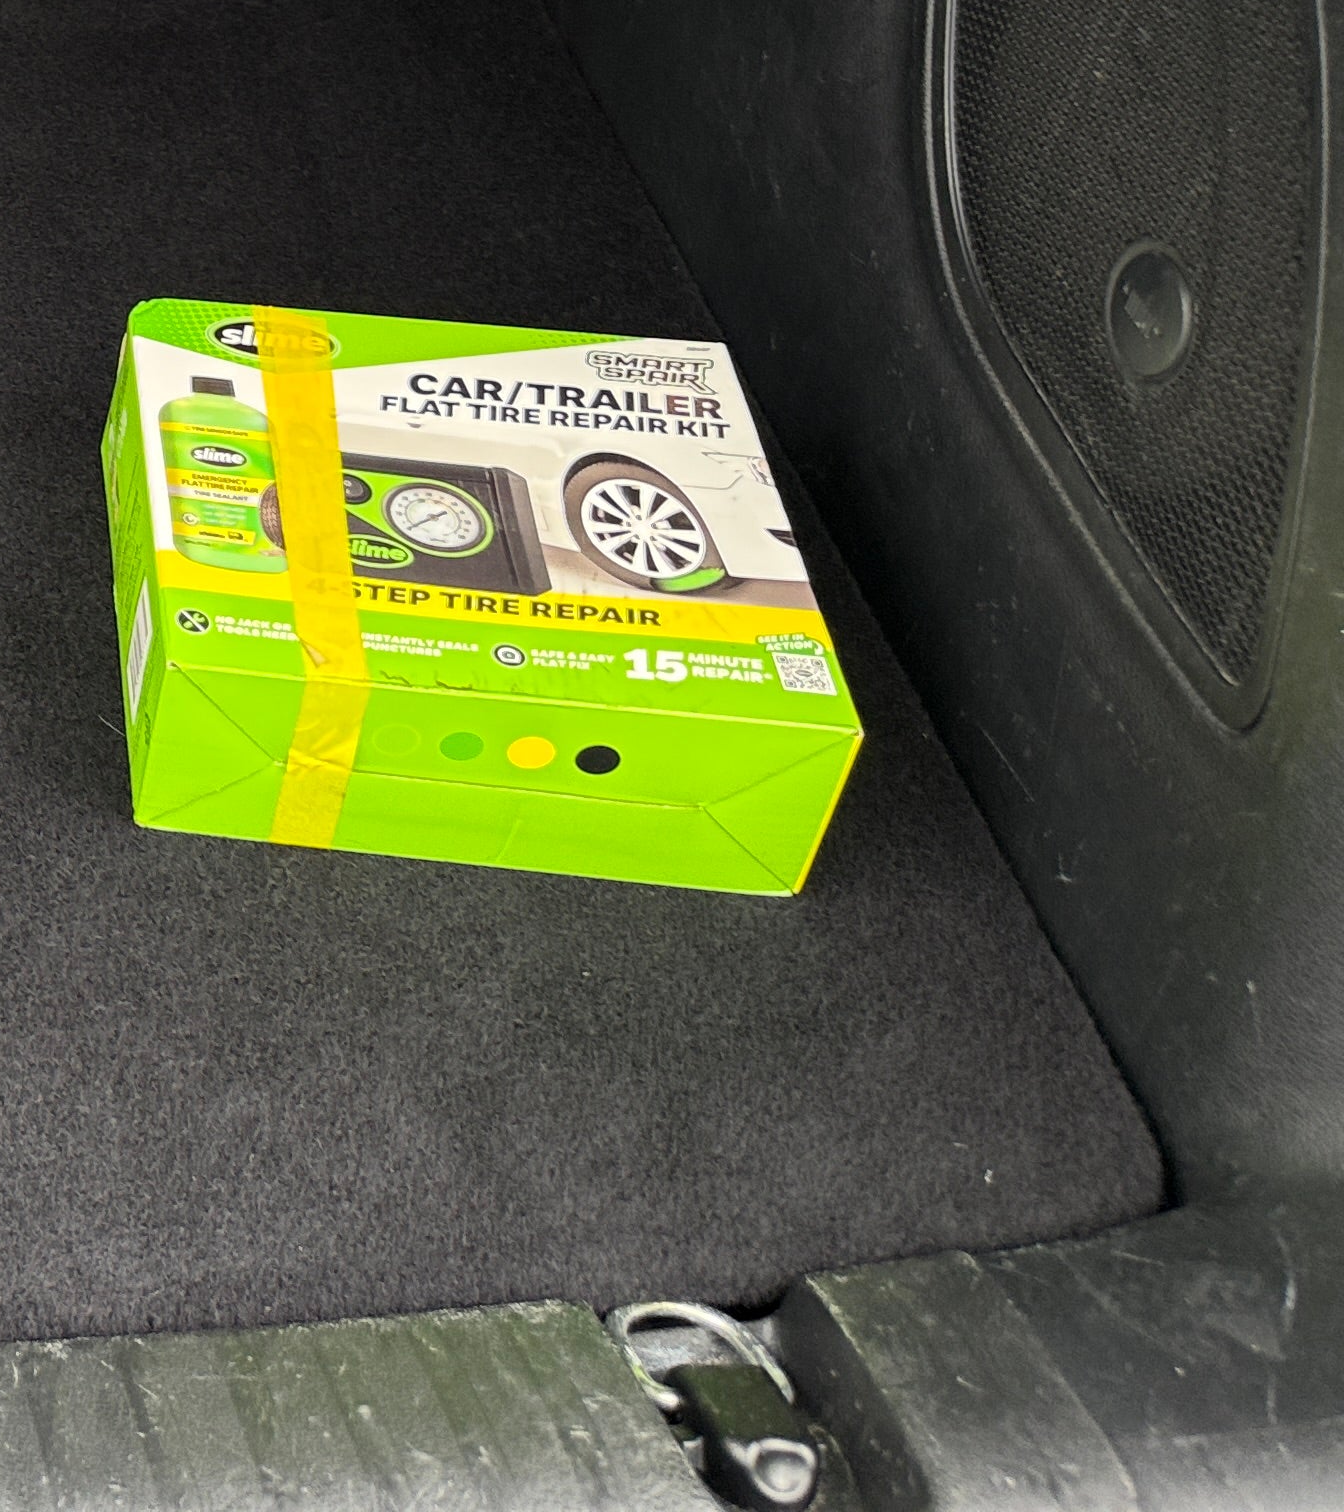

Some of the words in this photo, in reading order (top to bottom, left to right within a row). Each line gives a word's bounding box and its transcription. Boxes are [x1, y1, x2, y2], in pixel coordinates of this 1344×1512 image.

[592, 354, 708, 373] SMART
[602, 367, 707, 392] SPAIR
[408, 373, 724, 420] CAR/TRAILER
[380, 395, 461, 418] FLAT
[465, 402, 542, 425] TIRE
[547, 409, 669, 435] REPAIR
[676, 419, 731, 440] KIT
[193, 447, 245, 465] slime
[349, 539, 408, 561] lime
[439, 591, 520, 615] TIRE
[529, 599, 662, 626] REPAIR
[765, 640, 812, 652] ACTION
[623, 648, 688, 683] 15
[687, 652, 764, 670] MINUTE
